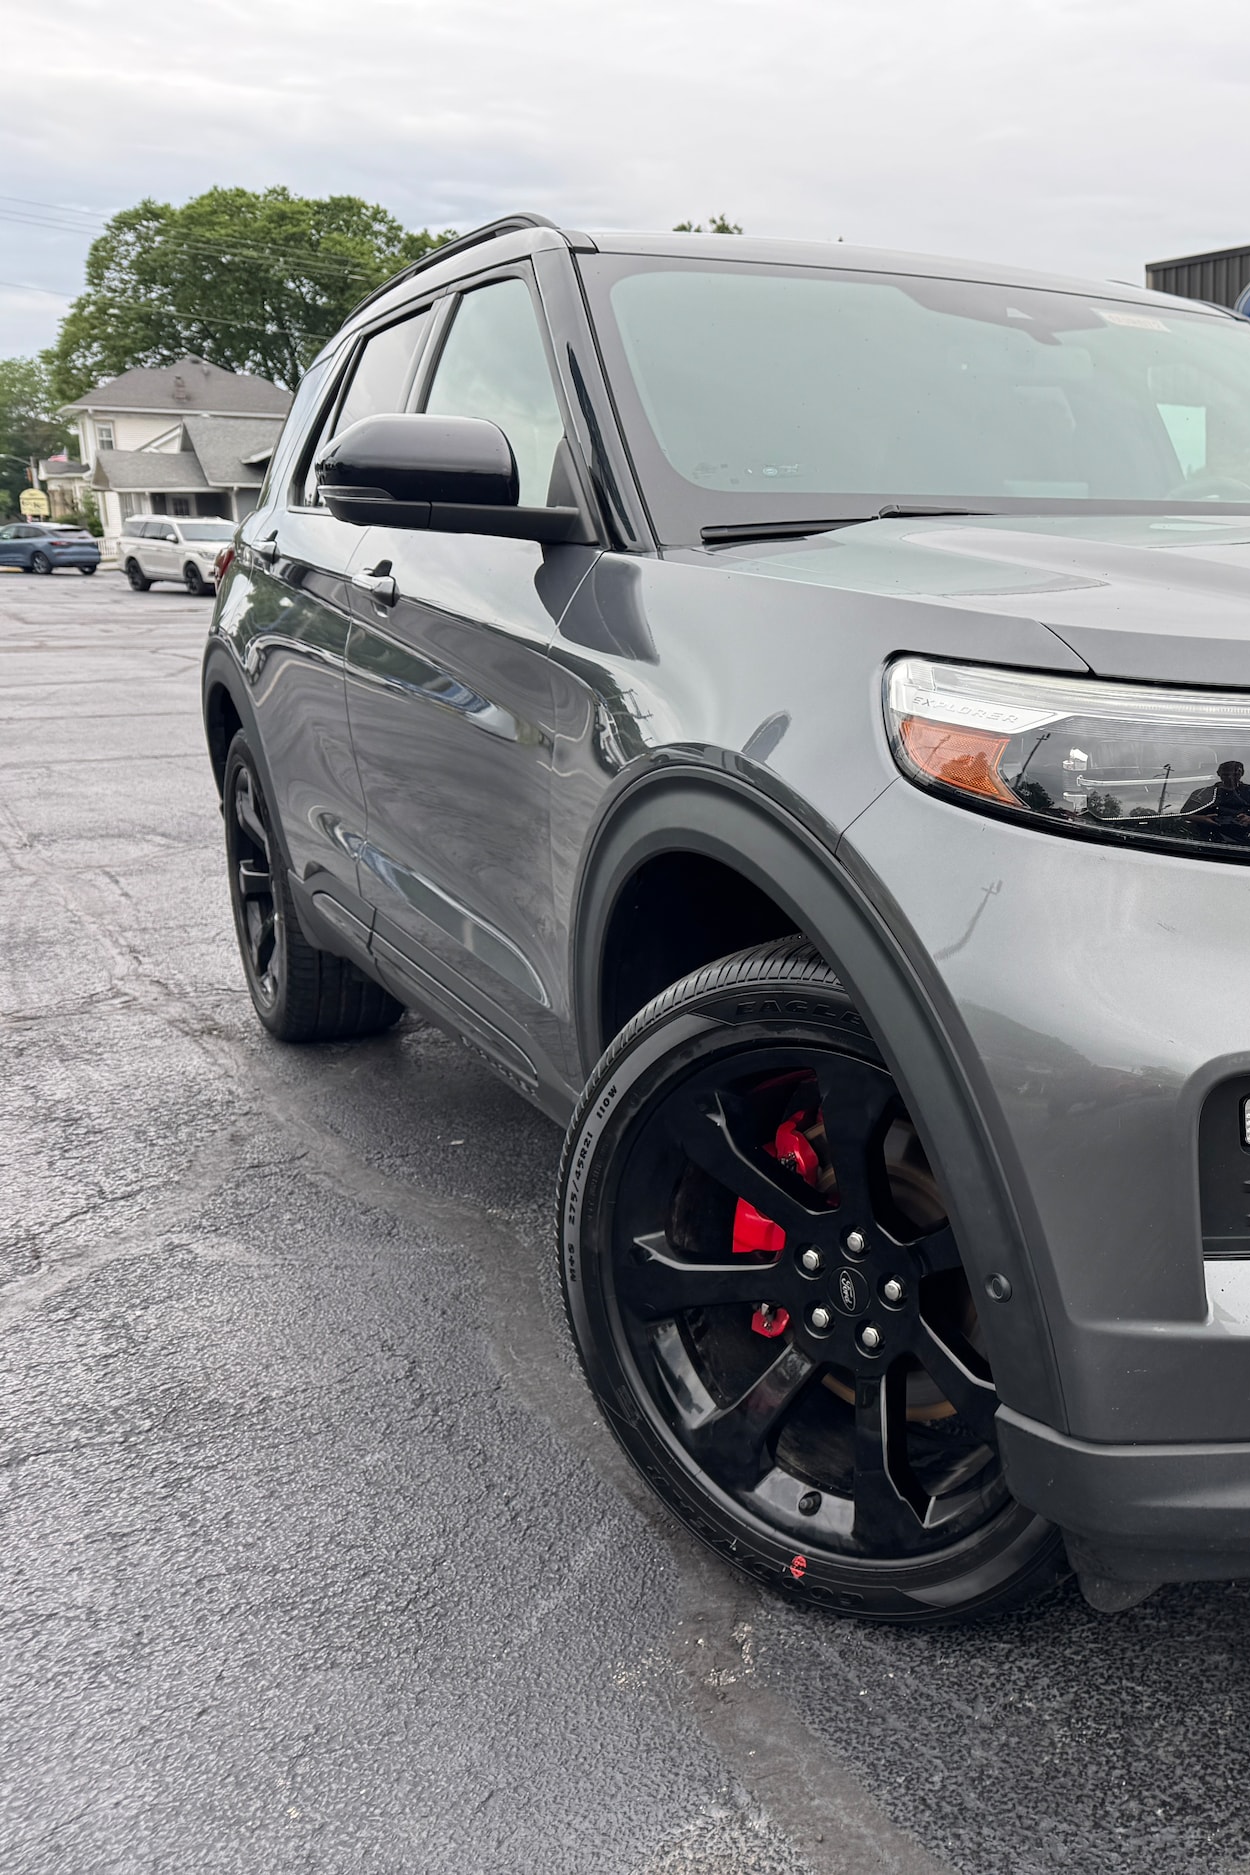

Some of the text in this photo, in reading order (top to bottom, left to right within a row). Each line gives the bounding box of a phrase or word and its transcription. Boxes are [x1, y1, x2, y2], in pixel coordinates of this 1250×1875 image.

[912, 696, 1019, 724] EXPLORER
[735, 999, 861, 1025] EAGLE
[567, 1131, 594, 1226] 275/45R21
[596, 1084, 619, 1120] 110W
[841, 1277, 853, 1304] Ford
